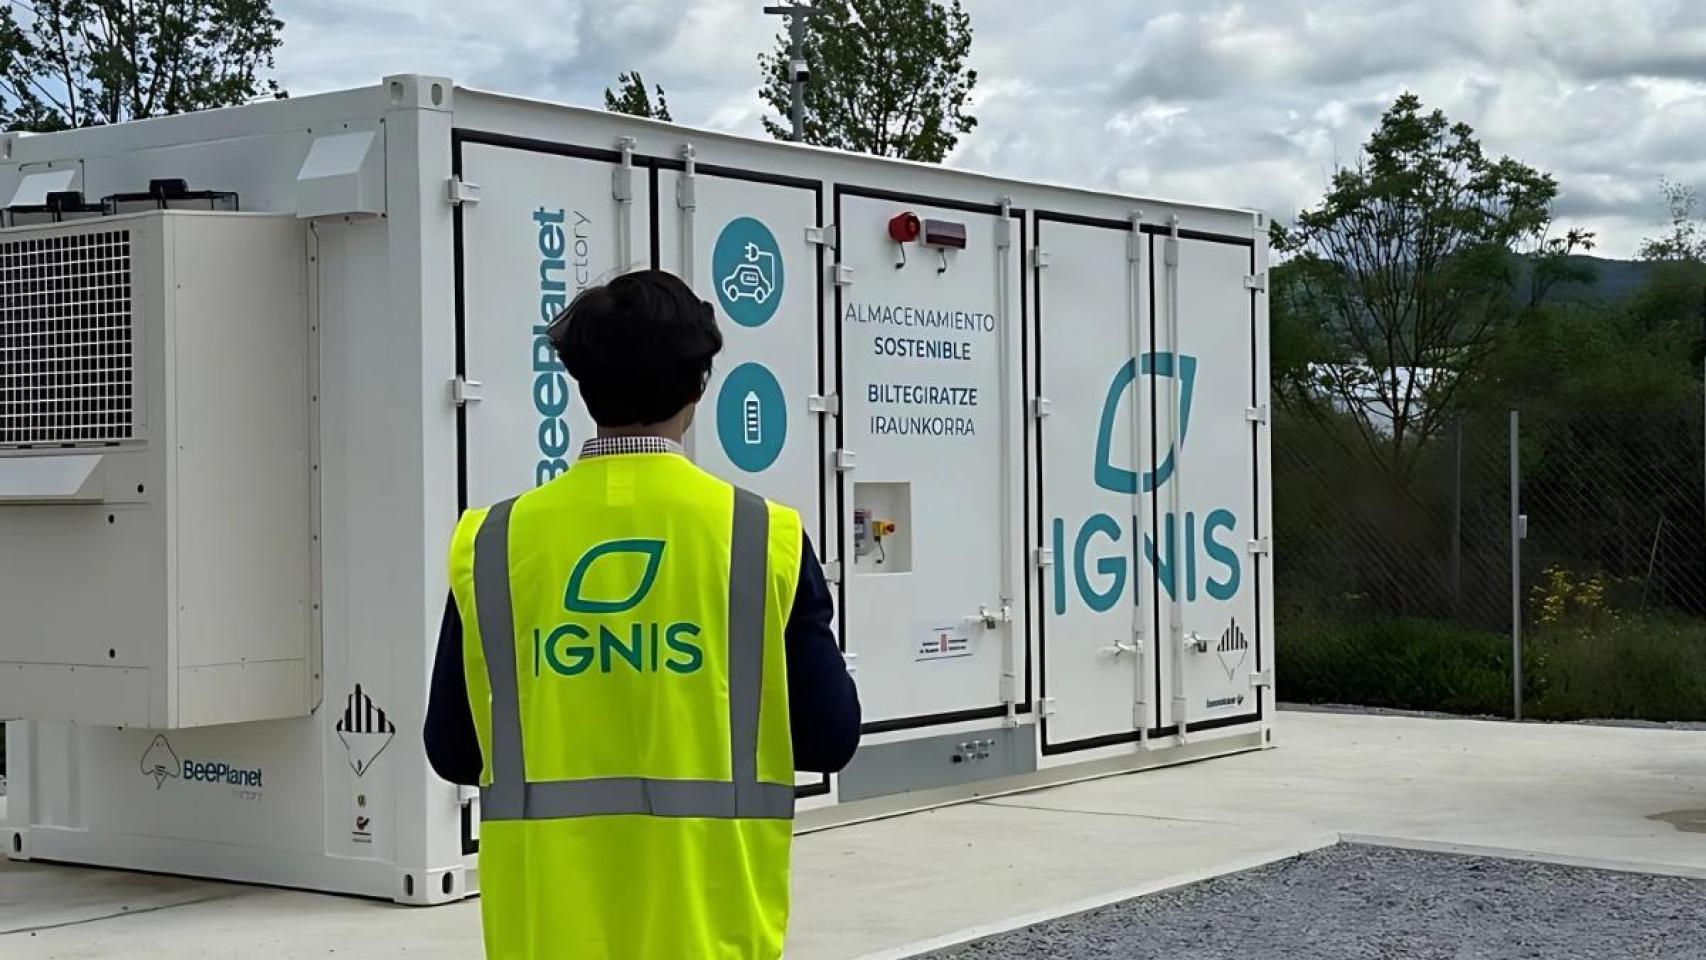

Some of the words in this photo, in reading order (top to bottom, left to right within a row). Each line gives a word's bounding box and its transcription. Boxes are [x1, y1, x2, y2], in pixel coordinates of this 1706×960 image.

[573, 210, 592, 291] ctory
[845, 302, 995, 332] ALMACENAMIENTO
[874, 337, 972, 361] SOSTENIBLE
[868, 384, 978, 406] BILTEGIRATZE
[870, 416, 976, 436] IRAUNKORRA
[1053, 508, 1241, 615] IGNIS
[534, 622, 703, 677] IGNIS
[183, 759, 263, 788] BeePlanet
